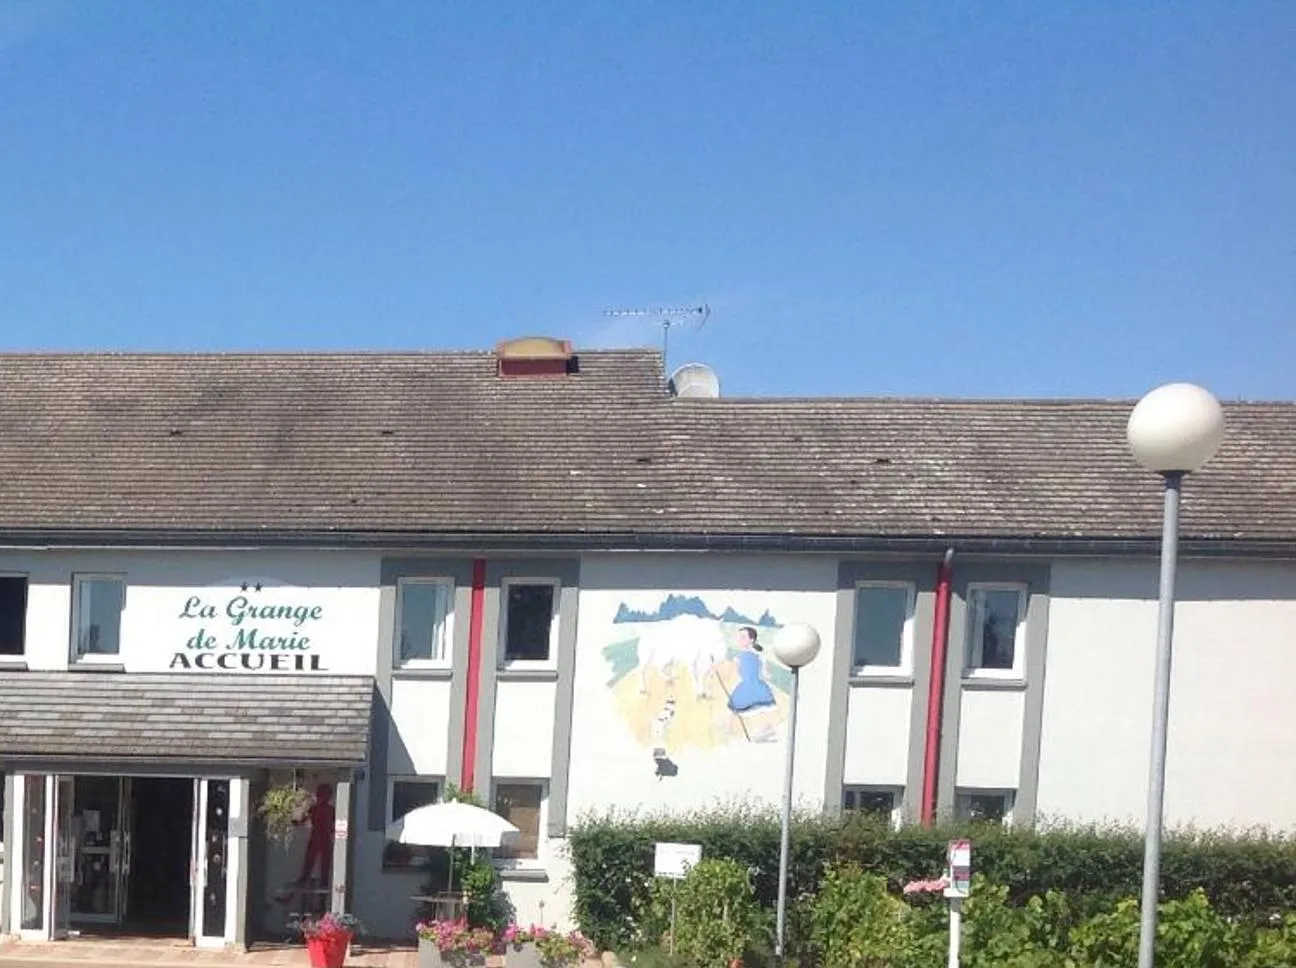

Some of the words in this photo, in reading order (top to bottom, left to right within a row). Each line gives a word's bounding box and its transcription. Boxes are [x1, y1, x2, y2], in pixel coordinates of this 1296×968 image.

[178, 595, 216, 618] La
[225, 595, 323, 627] Grange
[185, 627, 216, 650] de
[225, 627, 312, 650] Marie
[168, 651, 329, 671] ACCUEIL
